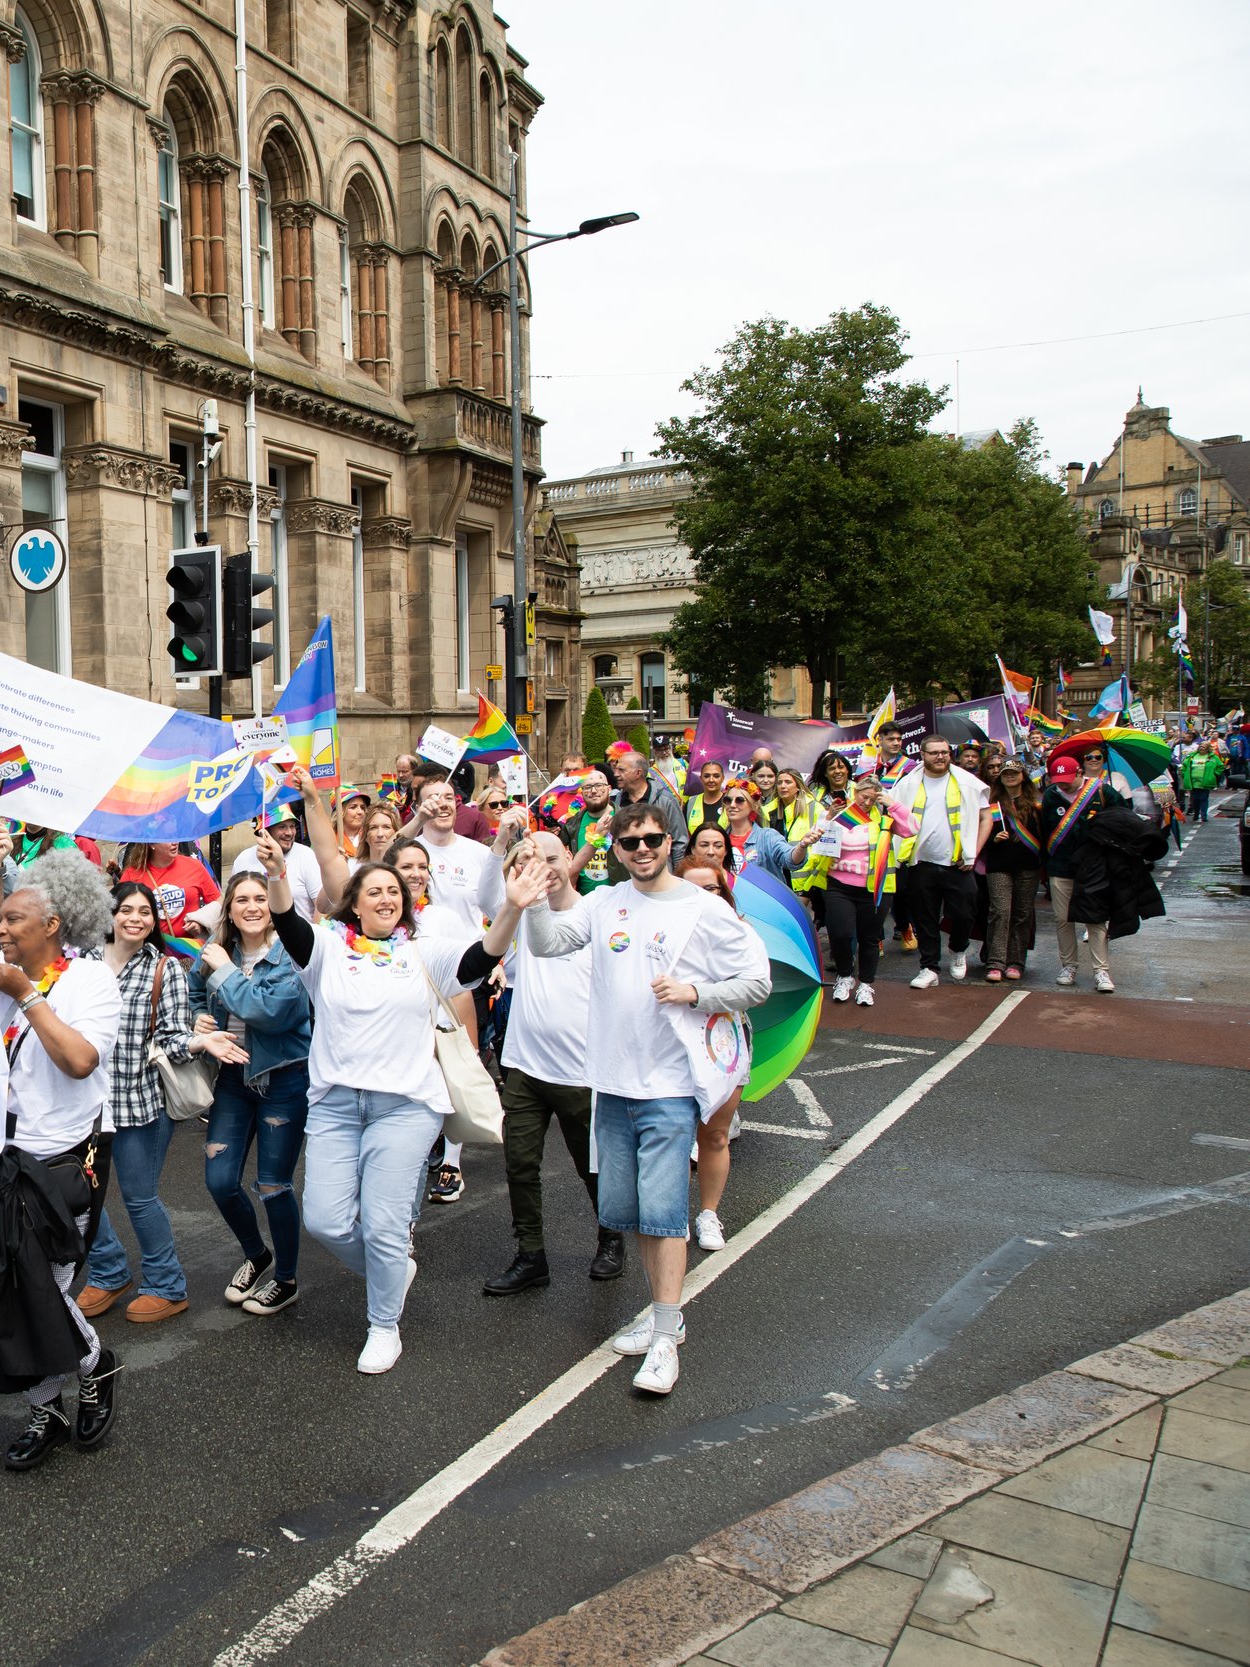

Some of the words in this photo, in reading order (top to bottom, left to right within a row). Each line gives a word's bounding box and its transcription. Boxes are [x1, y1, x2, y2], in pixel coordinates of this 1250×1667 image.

[28, 694, 76, 714] differences
[10, 707, 43, 727] thriving
[44, 721, 100, 742] communities
[242, 731, 280, 740] everyone
[902, 726, 926, 740] etwork
[41, 784, 48, 793] in
[50, 788, 64, 798] life
[194, 787, 219, 800] TO
